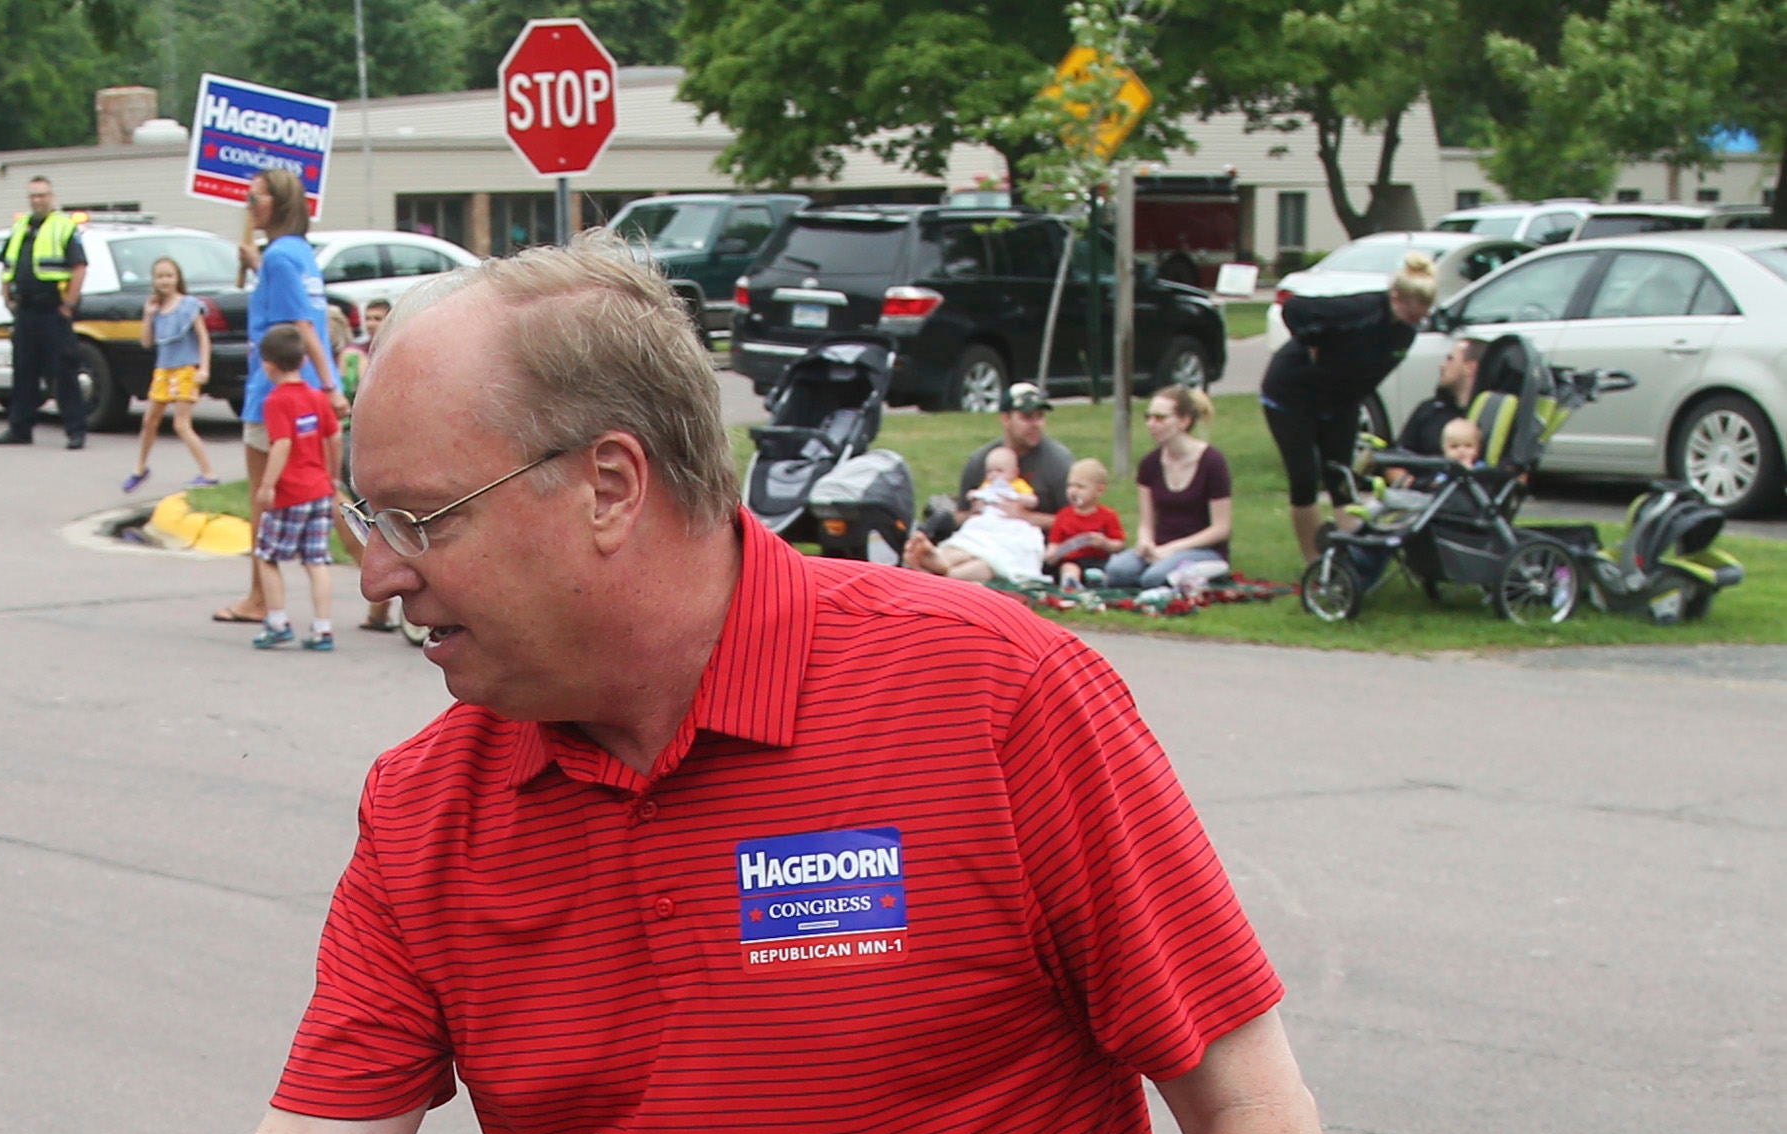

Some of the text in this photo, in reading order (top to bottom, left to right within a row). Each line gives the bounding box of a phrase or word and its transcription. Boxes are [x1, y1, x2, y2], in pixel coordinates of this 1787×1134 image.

[509, 69, 610, 131] STOP
[202, 94, 328, 150] HAGEDORN
[219, 146, 303, 178] CONGRESS
[741, 847, 899, 890] HAGEDORN
[769, 896, 871, 918] CONGRESS
[750, 939, 902, 964] REPUBLICAN MN-1
